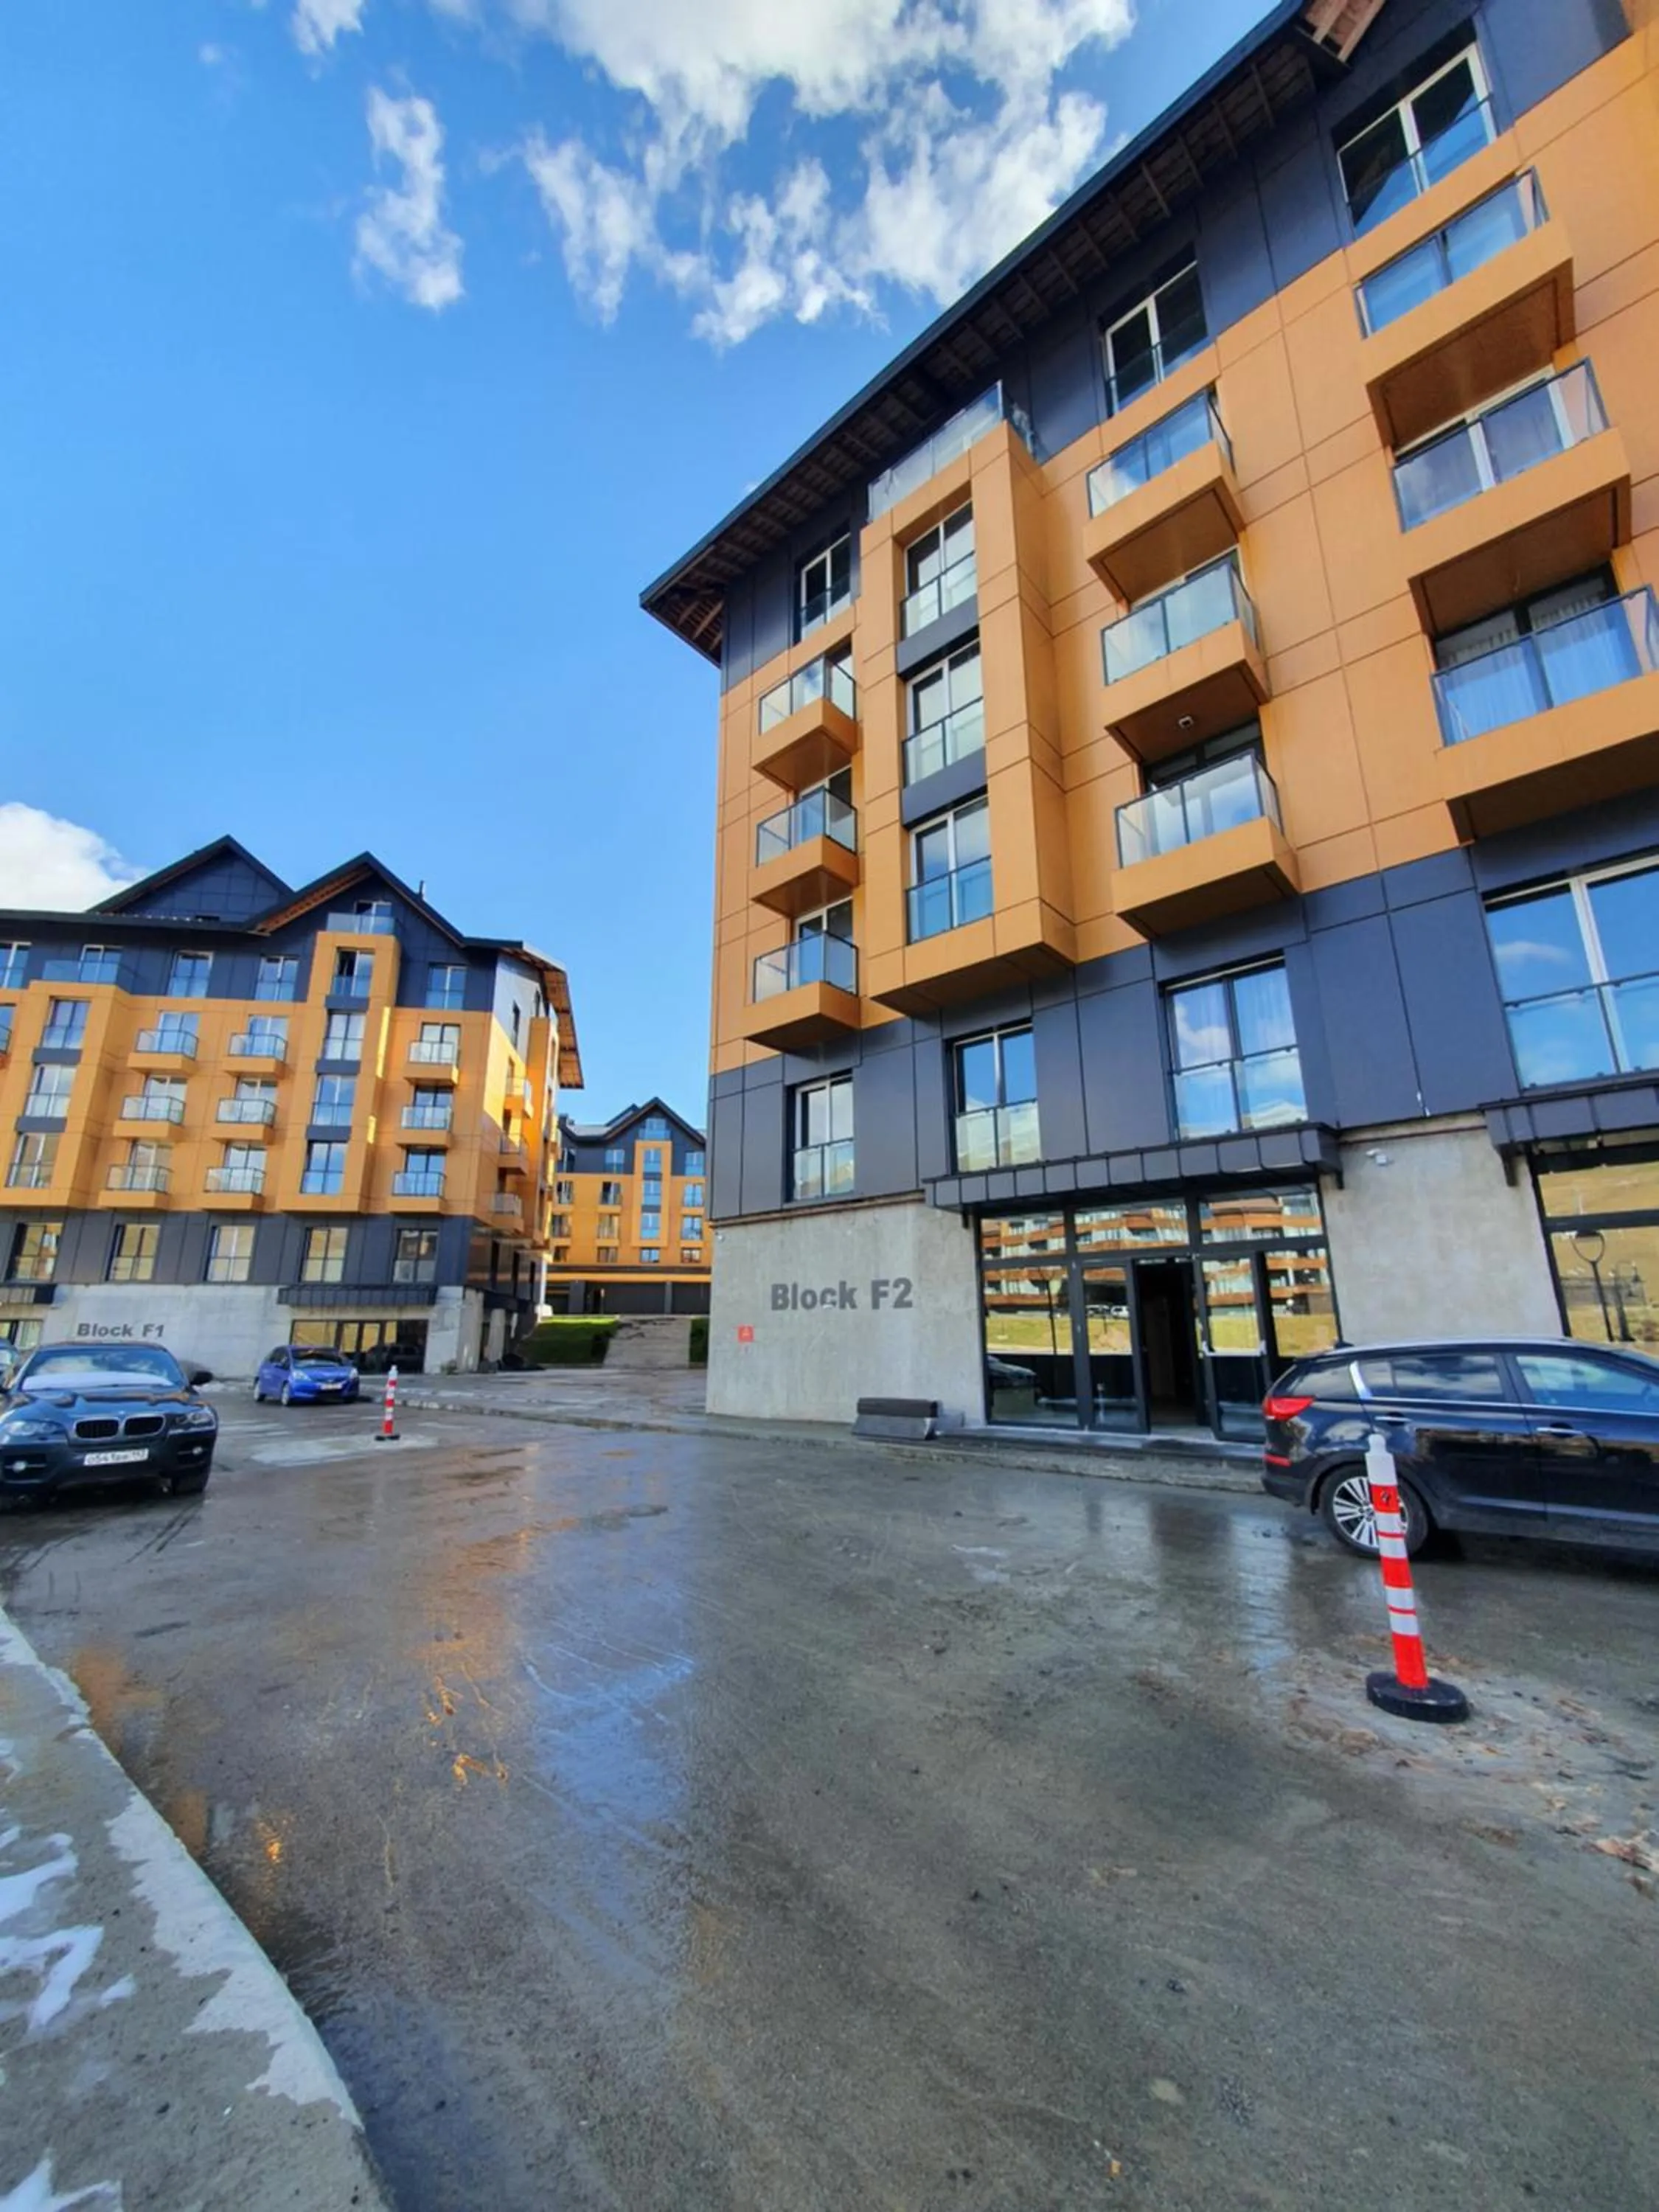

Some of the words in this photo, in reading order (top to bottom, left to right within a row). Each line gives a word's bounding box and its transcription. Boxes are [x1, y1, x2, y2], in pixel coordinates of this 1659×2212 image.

[771, 1280, 858, 1311] Block
[871, 1277, 914, 1310] F2
[77, 1323, 133, 1338] Block
[142, 1324, 164, 1338] F1
